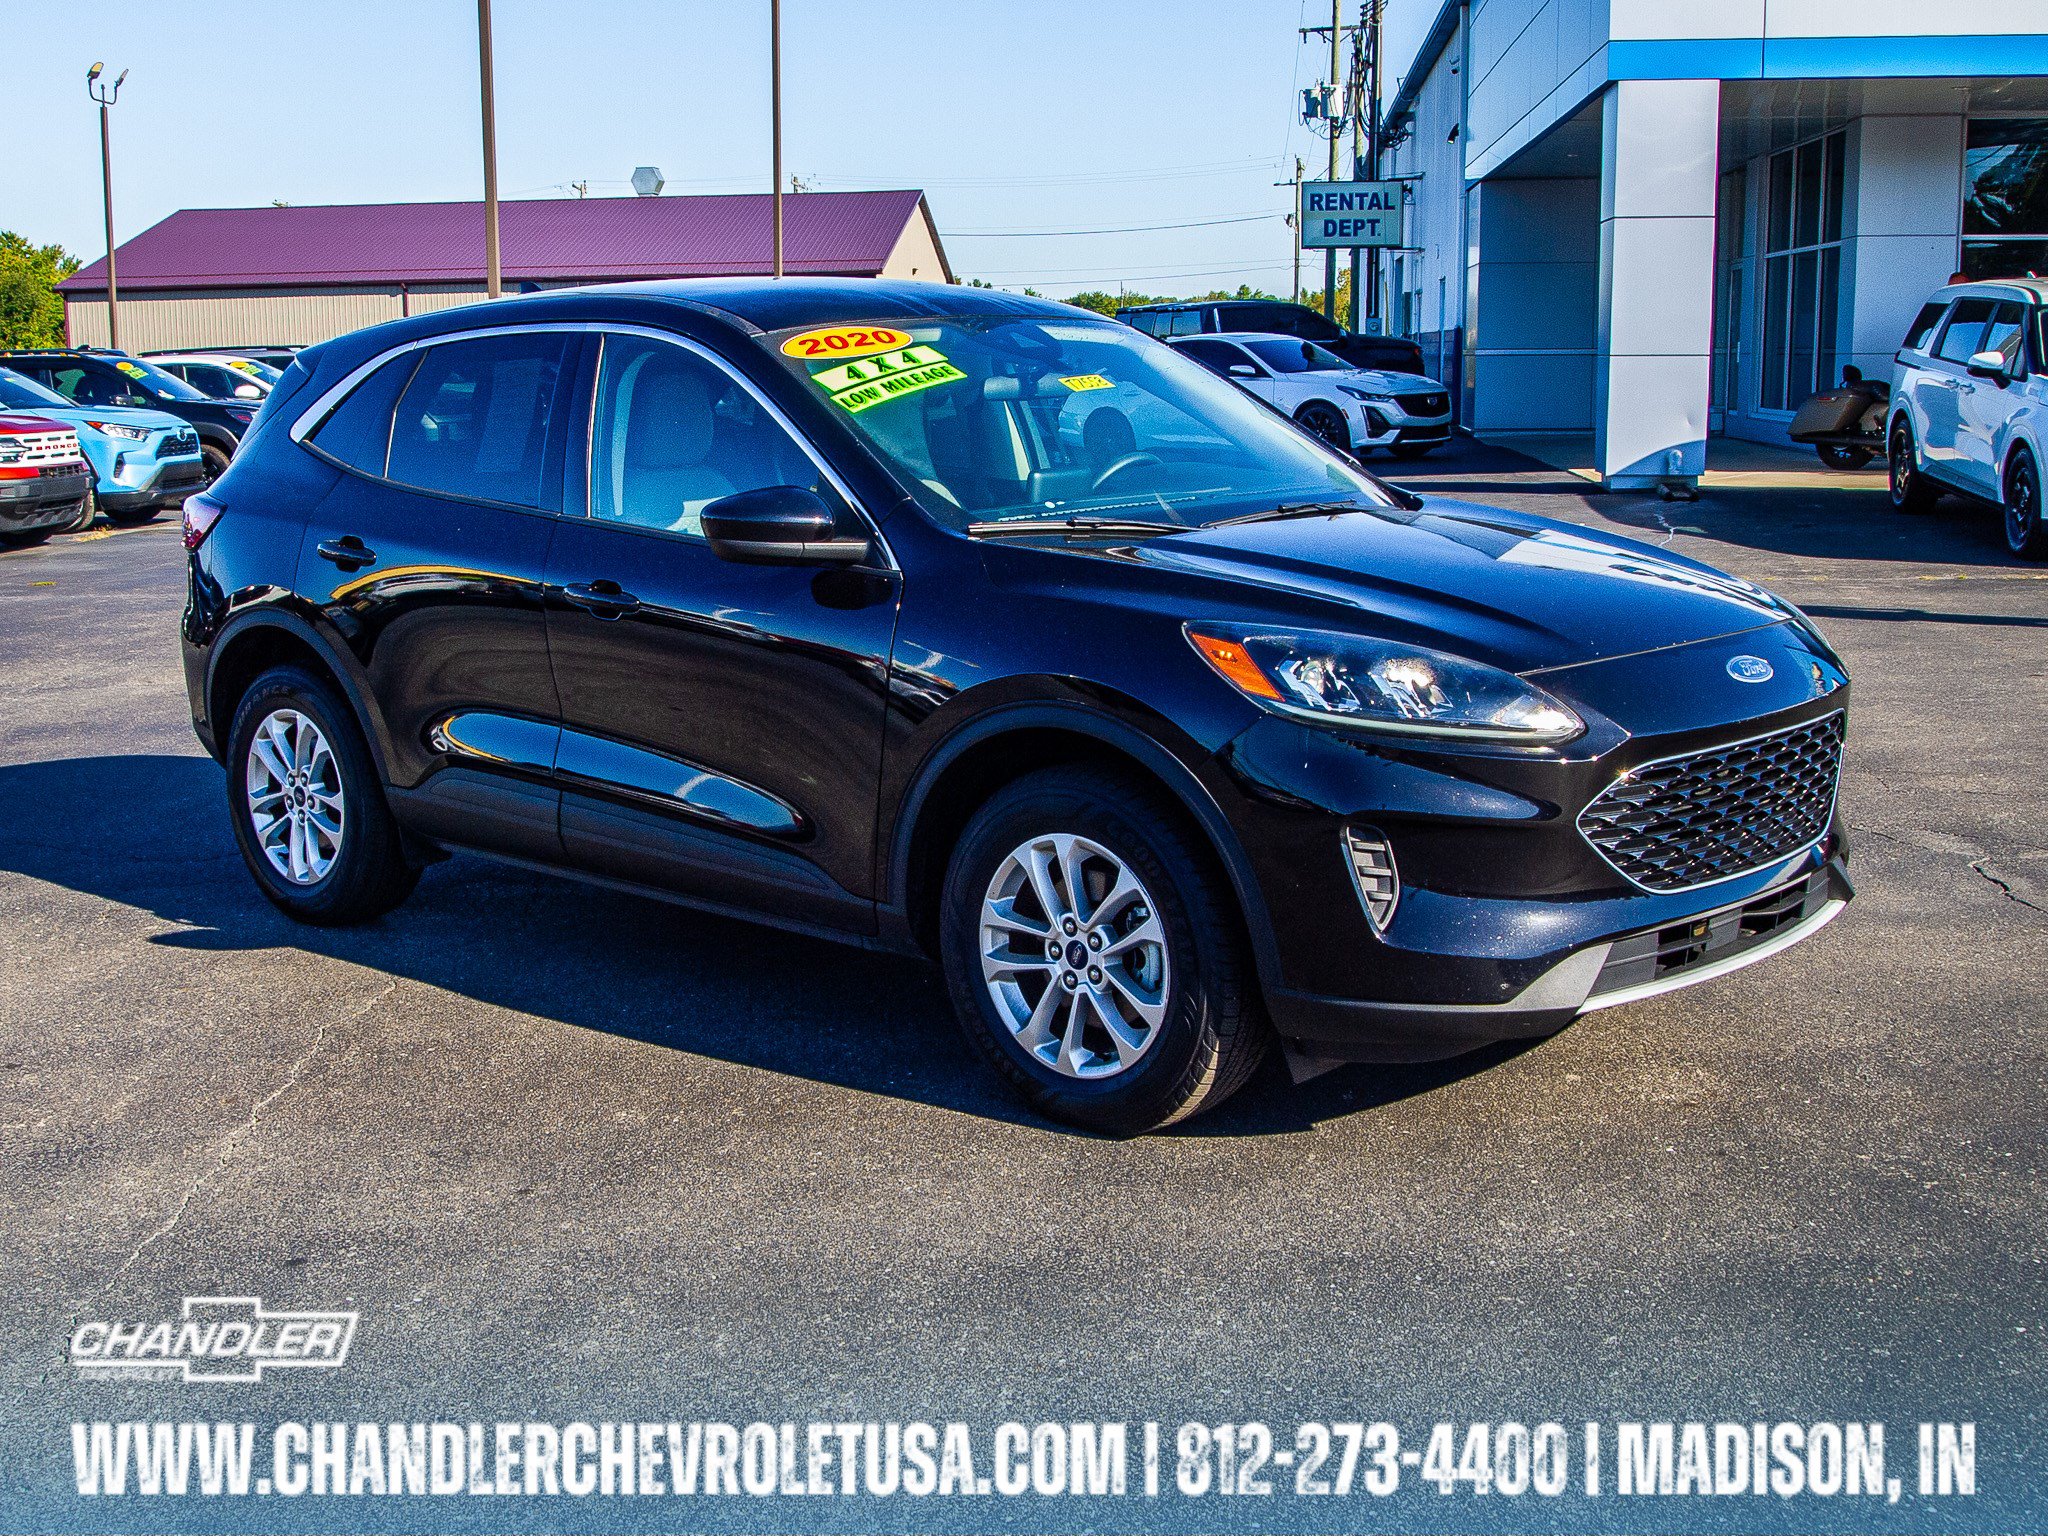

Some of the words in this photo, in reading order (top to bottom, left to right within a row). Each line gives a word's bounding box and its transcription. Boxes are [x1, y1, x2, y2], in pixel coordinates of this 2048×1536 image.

[1309, 192, 1395, 211] RENTAL
[1323, 218, 1381, 237] DEPT.
[798, 330, 897, 355] 2020
[847, 365, 865, 380] 4
[902, 351, 919, 364] 4
[840, 387, 881, 409] LOW
[881, 365, 956, 393] MILEAGE
[1738, 659, 1767, 676] Ford
